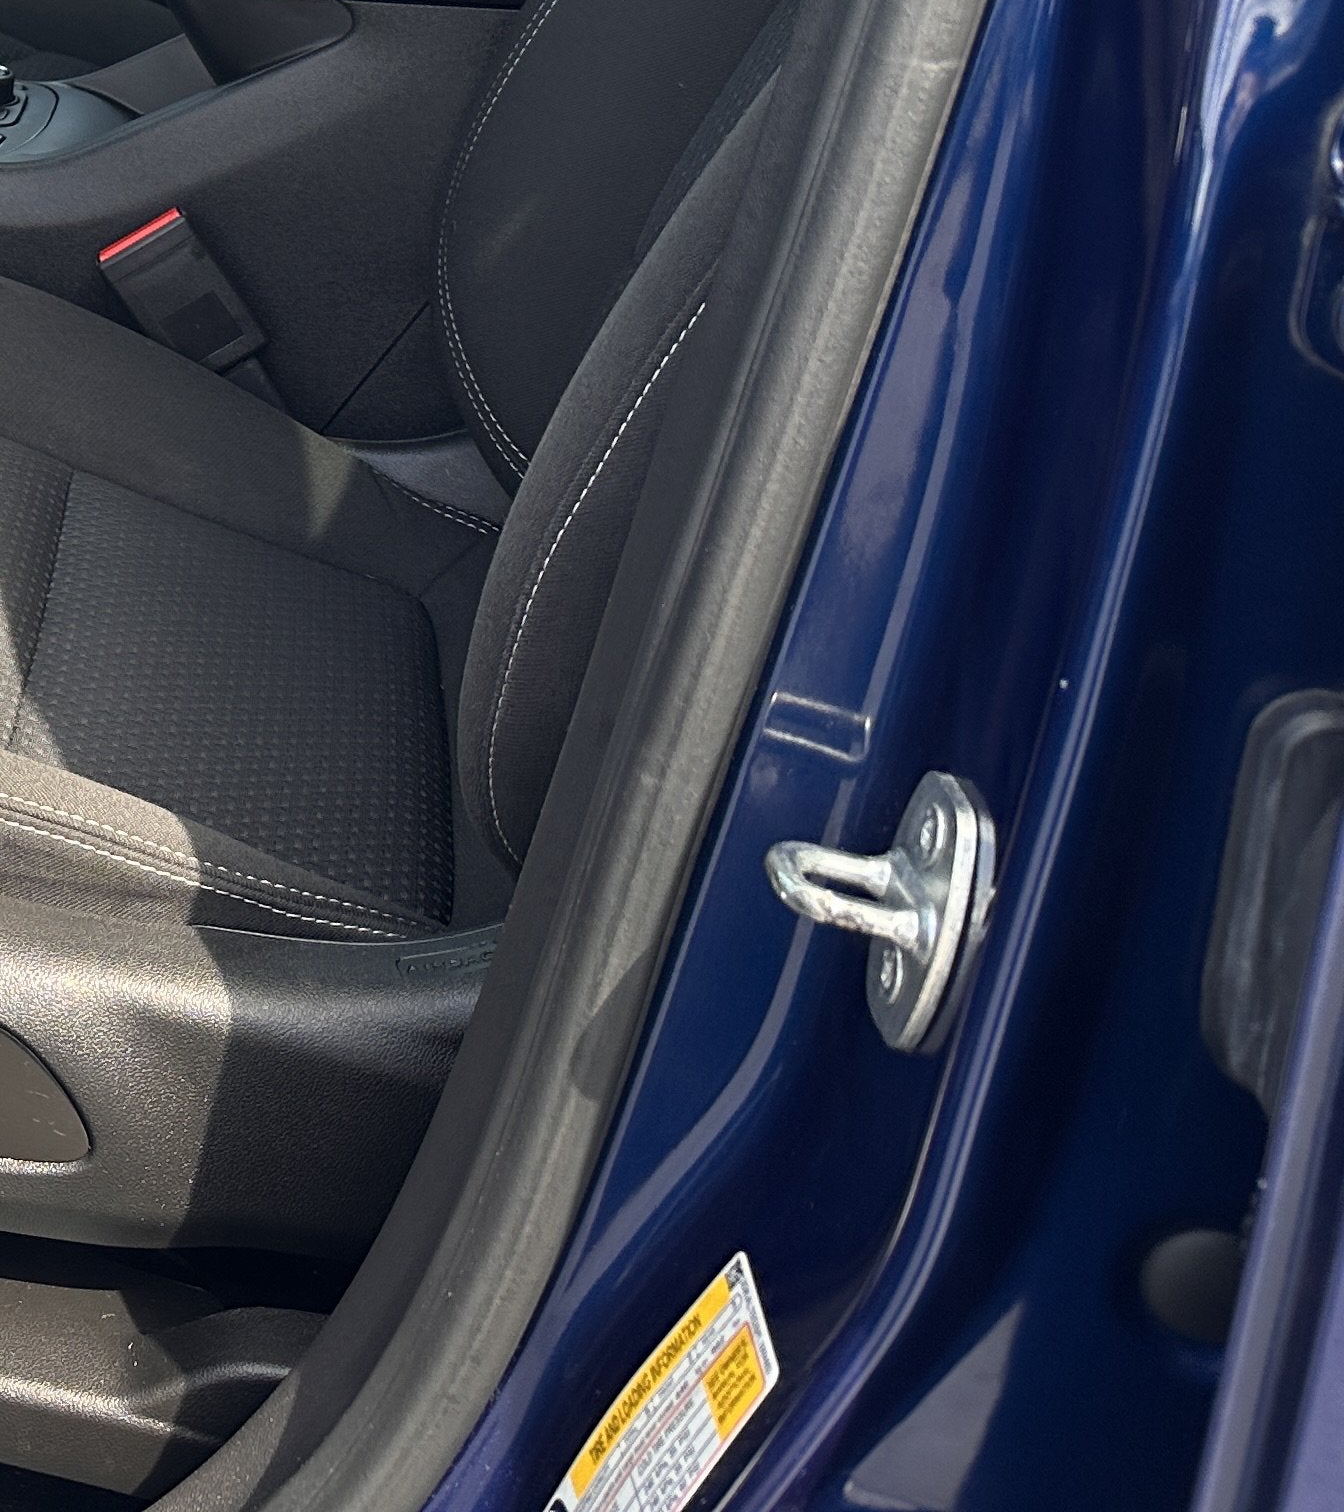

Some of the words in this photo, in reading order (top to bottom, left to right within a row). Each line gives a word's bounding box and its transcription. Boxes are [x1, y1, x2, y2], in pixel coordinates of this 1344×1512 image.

[589, 1432, 607, 1465] TIRE
[604, 1414, 622, 1445] AND
[617, 1372, 652, 1425] LOADING
[649, 1313, 702, 1383] INFORMATION
